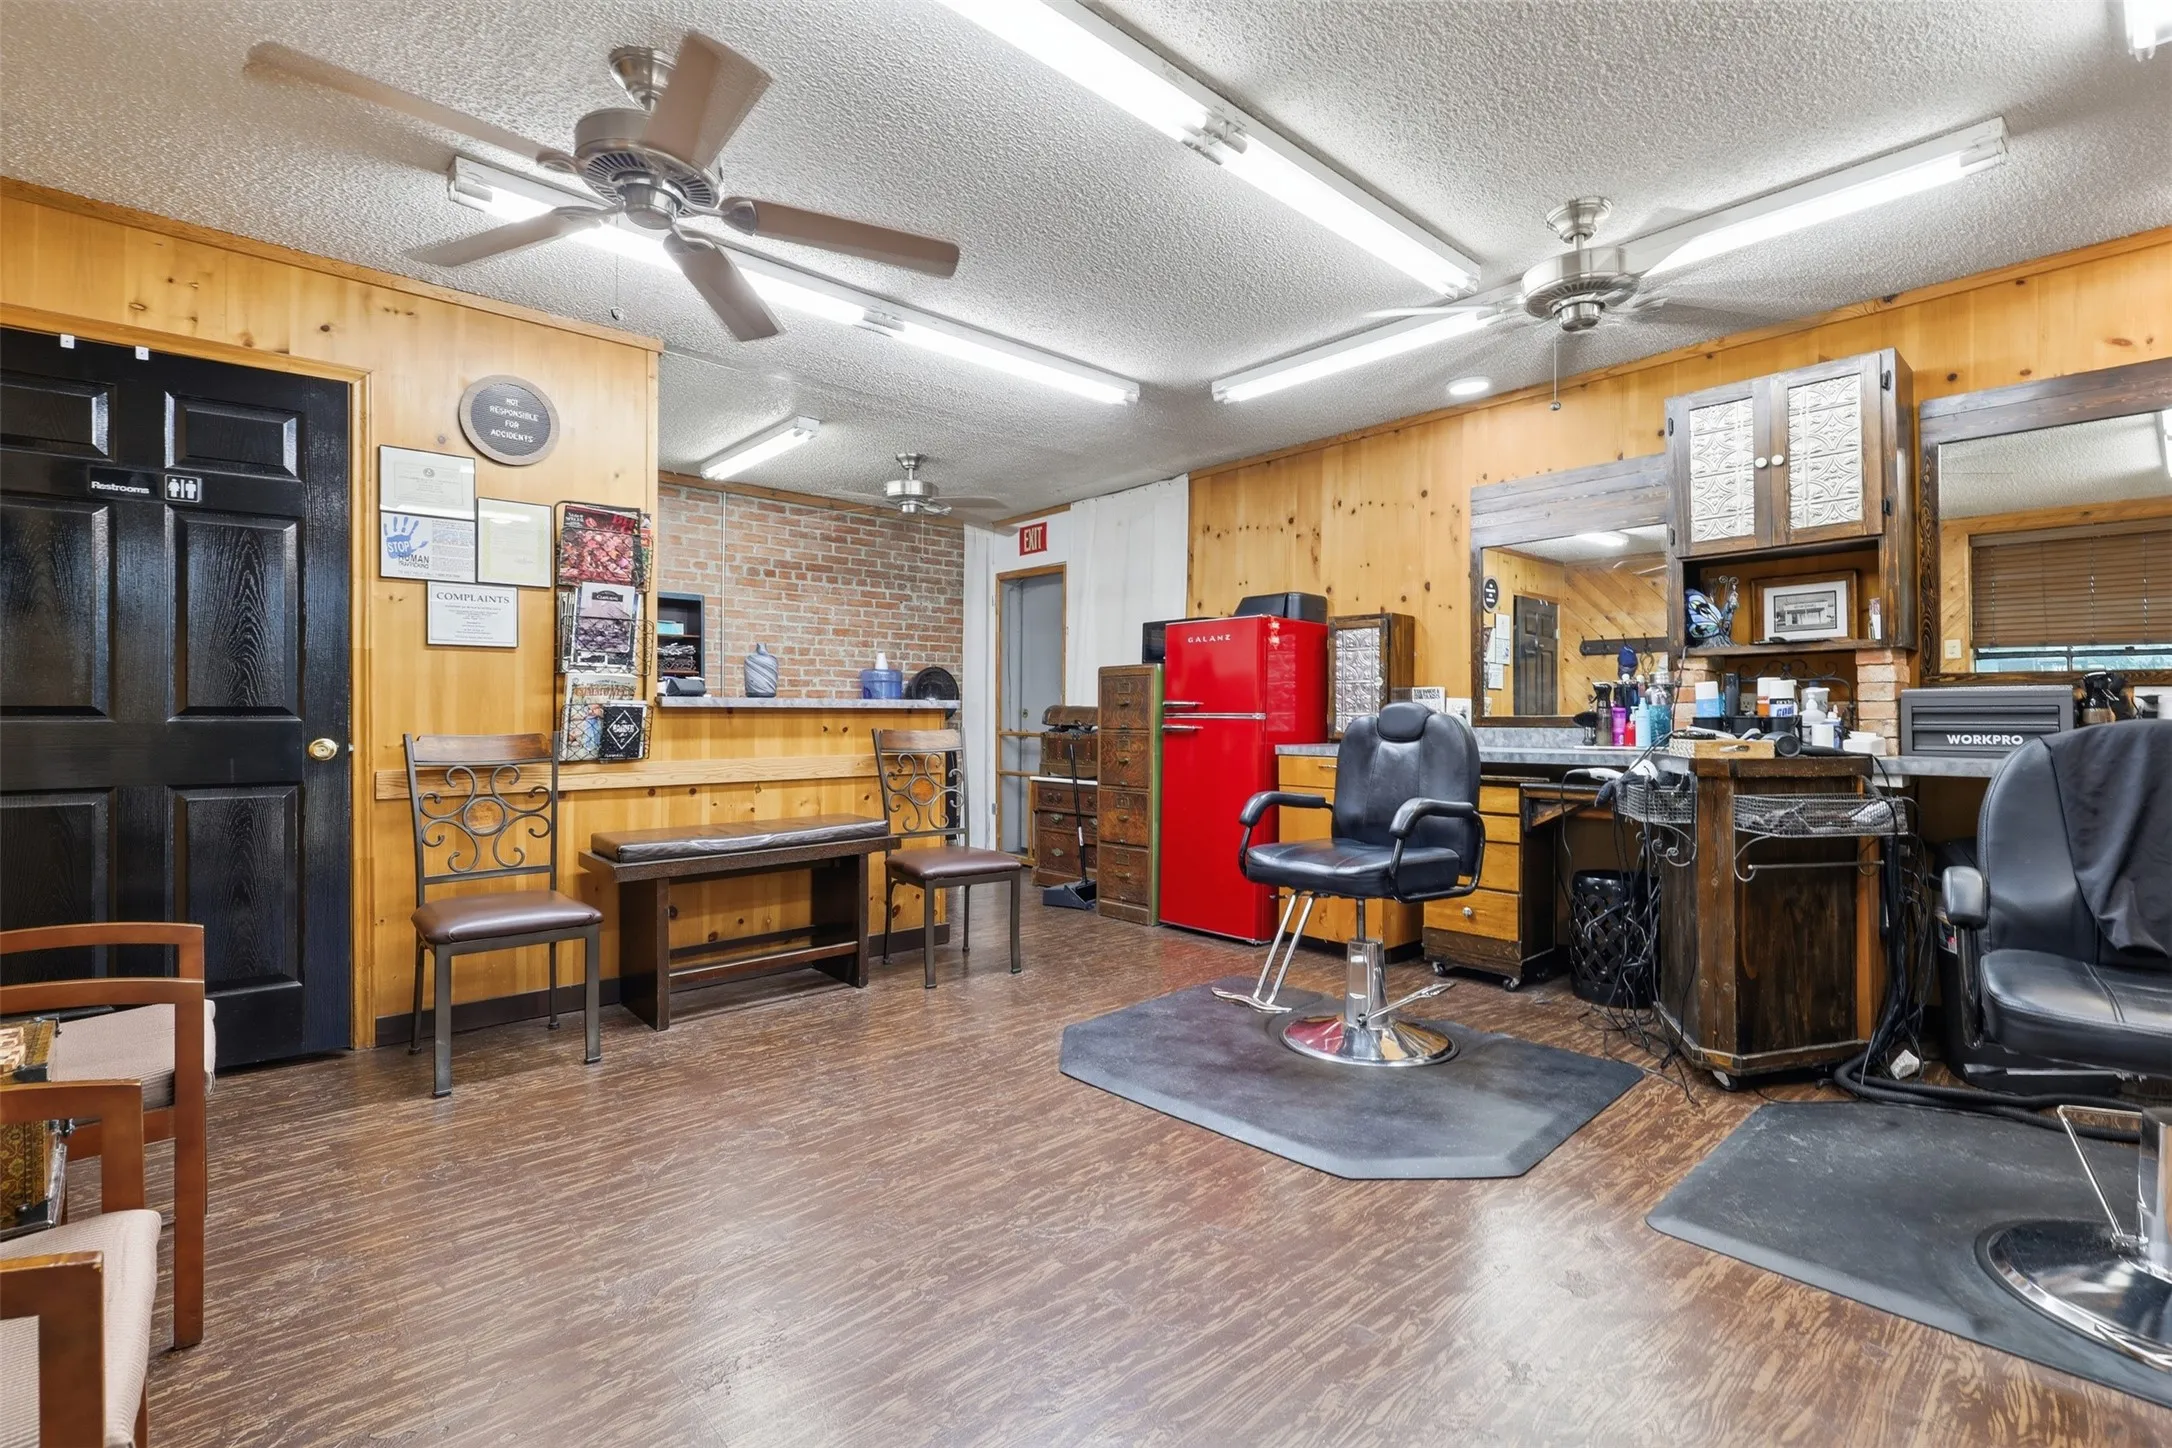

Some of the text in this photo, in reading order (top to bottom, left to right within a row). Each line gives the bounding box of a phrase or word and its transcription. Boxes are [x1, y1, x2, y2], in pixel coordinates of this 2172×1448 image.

[506, 398, 519, 406] NOT
[490, 406, 539, 422] RESPONSIBLE
[505, 420, 520, 429] FOR
[490, 429, 534, 443] ACCIDENTS
[91, 481, 150, 494] Restrooms
[1024, 526, 1043, 552] EXIT
[388, 541, 410, 553] STOP
[399, 554, 430, 564] HUMAN
[436, 592, 511, 604] COMPLAINTS
[1188, 634, 1231, 643] GALANZ
[1946, 734, 2024, 745] WORKPRO
